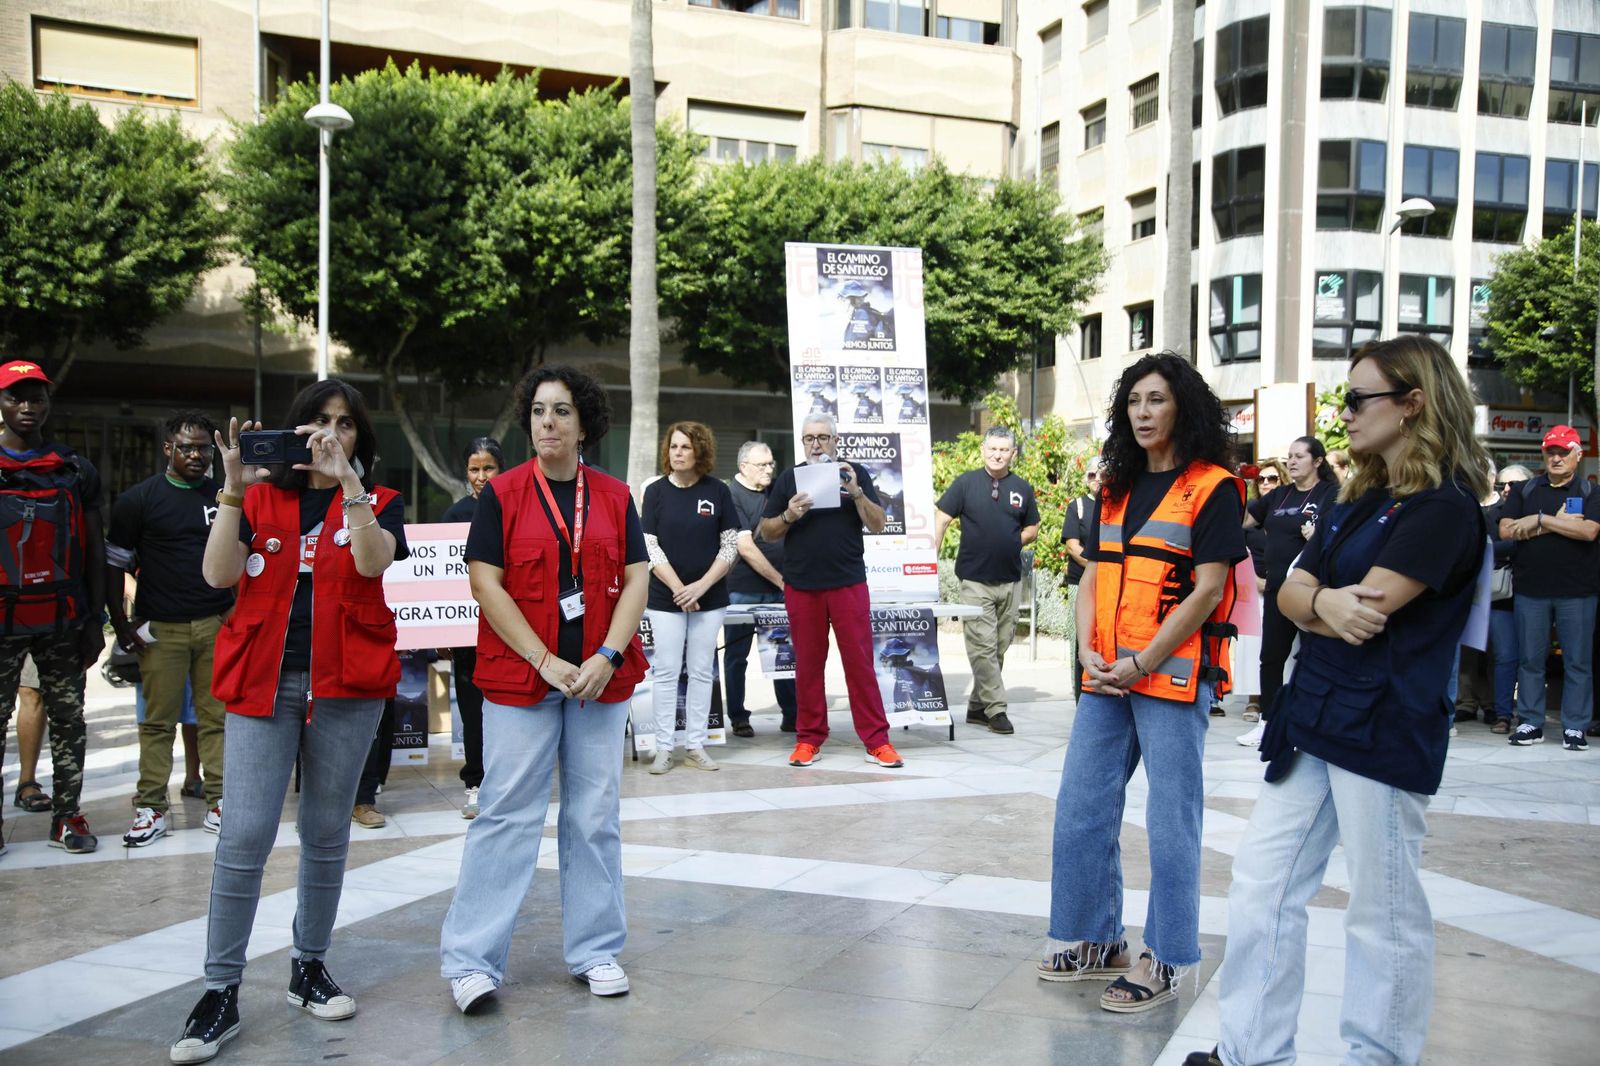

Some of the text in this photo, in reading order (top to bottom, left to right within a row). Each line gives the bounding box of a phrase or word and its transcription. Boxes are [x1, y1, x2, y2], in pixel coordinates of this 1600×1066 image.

[827, 252, 880, 265] EL CAMINO
[822, 263, 888, 277] DE SANTIAGO
[868, 341, 894, 350] JUNTOS
[847, 436, 889, 447] CAMINO
[846, 447, 897, 459] SANTIAGO
[413, 564, 434, 576] UN
[871, 565, 901, 573] Accem
[878, 609, 921, 619] CAMINO
[640, 620, 651, 631] EL
[878, 620, 930, 632] SANTIAGO
[917, 701, 944, 709] JUNTOS
